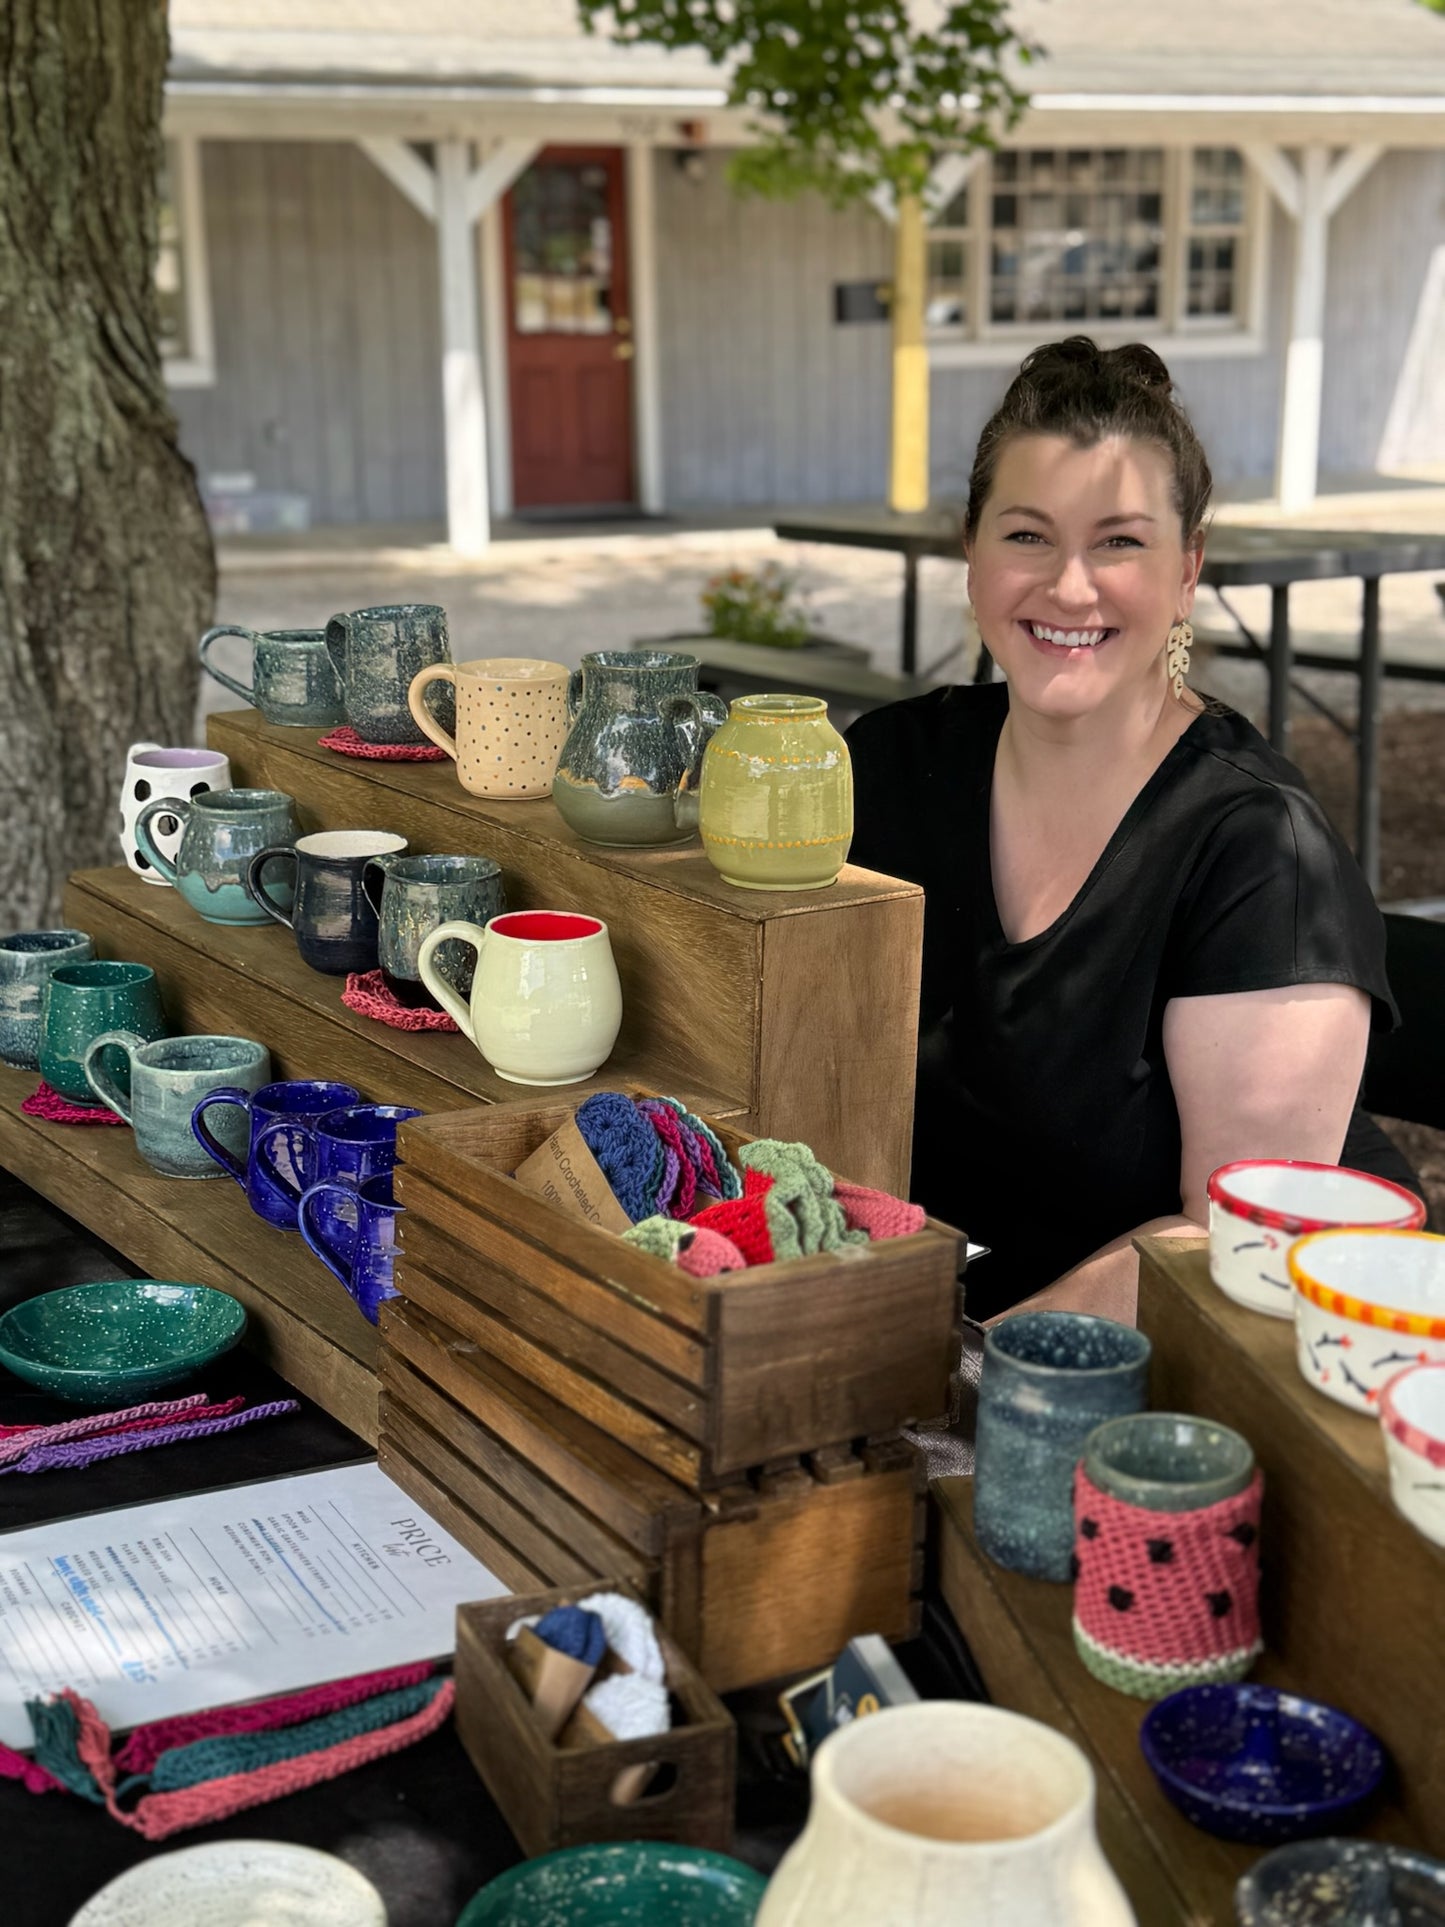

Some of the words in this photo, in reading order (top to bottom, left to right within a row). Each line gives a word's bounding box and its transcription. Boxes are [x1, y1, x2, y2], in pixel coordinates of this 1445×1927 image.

[549, 1134, 566, 1161] Hand
[559, 1157, 595, 1214] Crocheted
[351, 1543, 381, 1570] KITCHEN
[390, 1518, 452, 1567] PRICE
[207, 1576, 229, 1595] HOME
